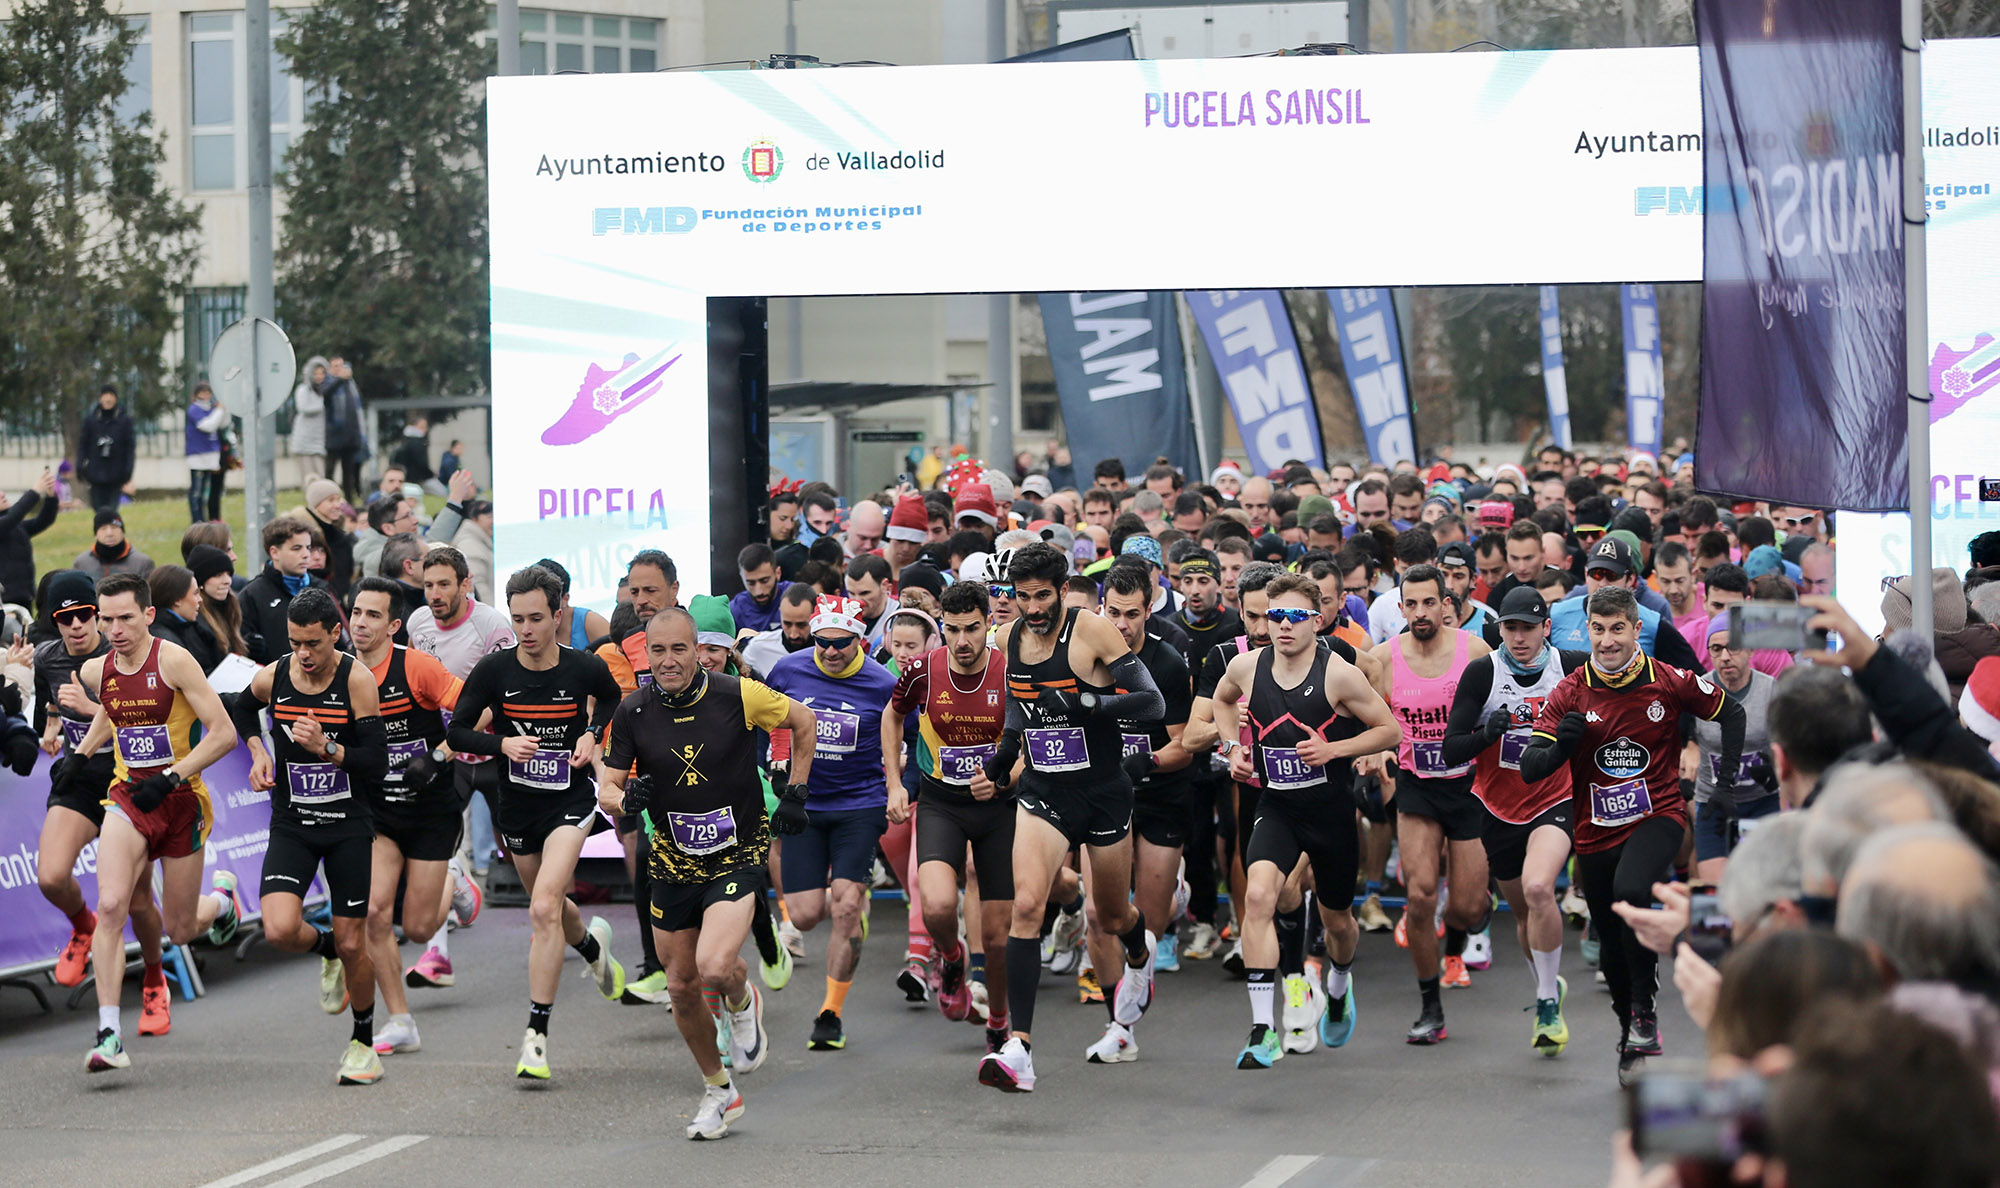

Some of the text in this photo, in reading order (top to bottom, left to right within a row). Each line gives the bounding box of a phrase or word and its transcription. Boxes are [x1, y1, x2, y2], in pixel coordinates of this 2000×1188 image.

[1145, 88, 1371, 128] PUCELA SANSIL
[1922, 125, 2000, 148] lladoli
[535, 151, 726, 182] Ayuntamiento
[805, 149, 945, 171] de Valladolid
[592, 206, 698, 236] FMD
[701, 204, 923, 220] Fundación Municipal
[742, 219, 883, 235] de Deportes
[534, 724, 568, 735] VICKY
[955, 726, 982, 734] VINO
[128, 736, 155, 754] 238
[683, 744, 695, 759] S
[1044, 739, 1066, 758] 32
[1603, 748, 1641, 758] Estrella
[523, 758, 558, 776] 1059
[955, 754, 984, 773] 283
[1604, 757, 1639, 767] Galicia
[300, 772, 337, 790] 1727
[686, 772, 698, 787] R
[1600, 792, 1638, 813] 1652
[686, 823, 719, 841] 729
